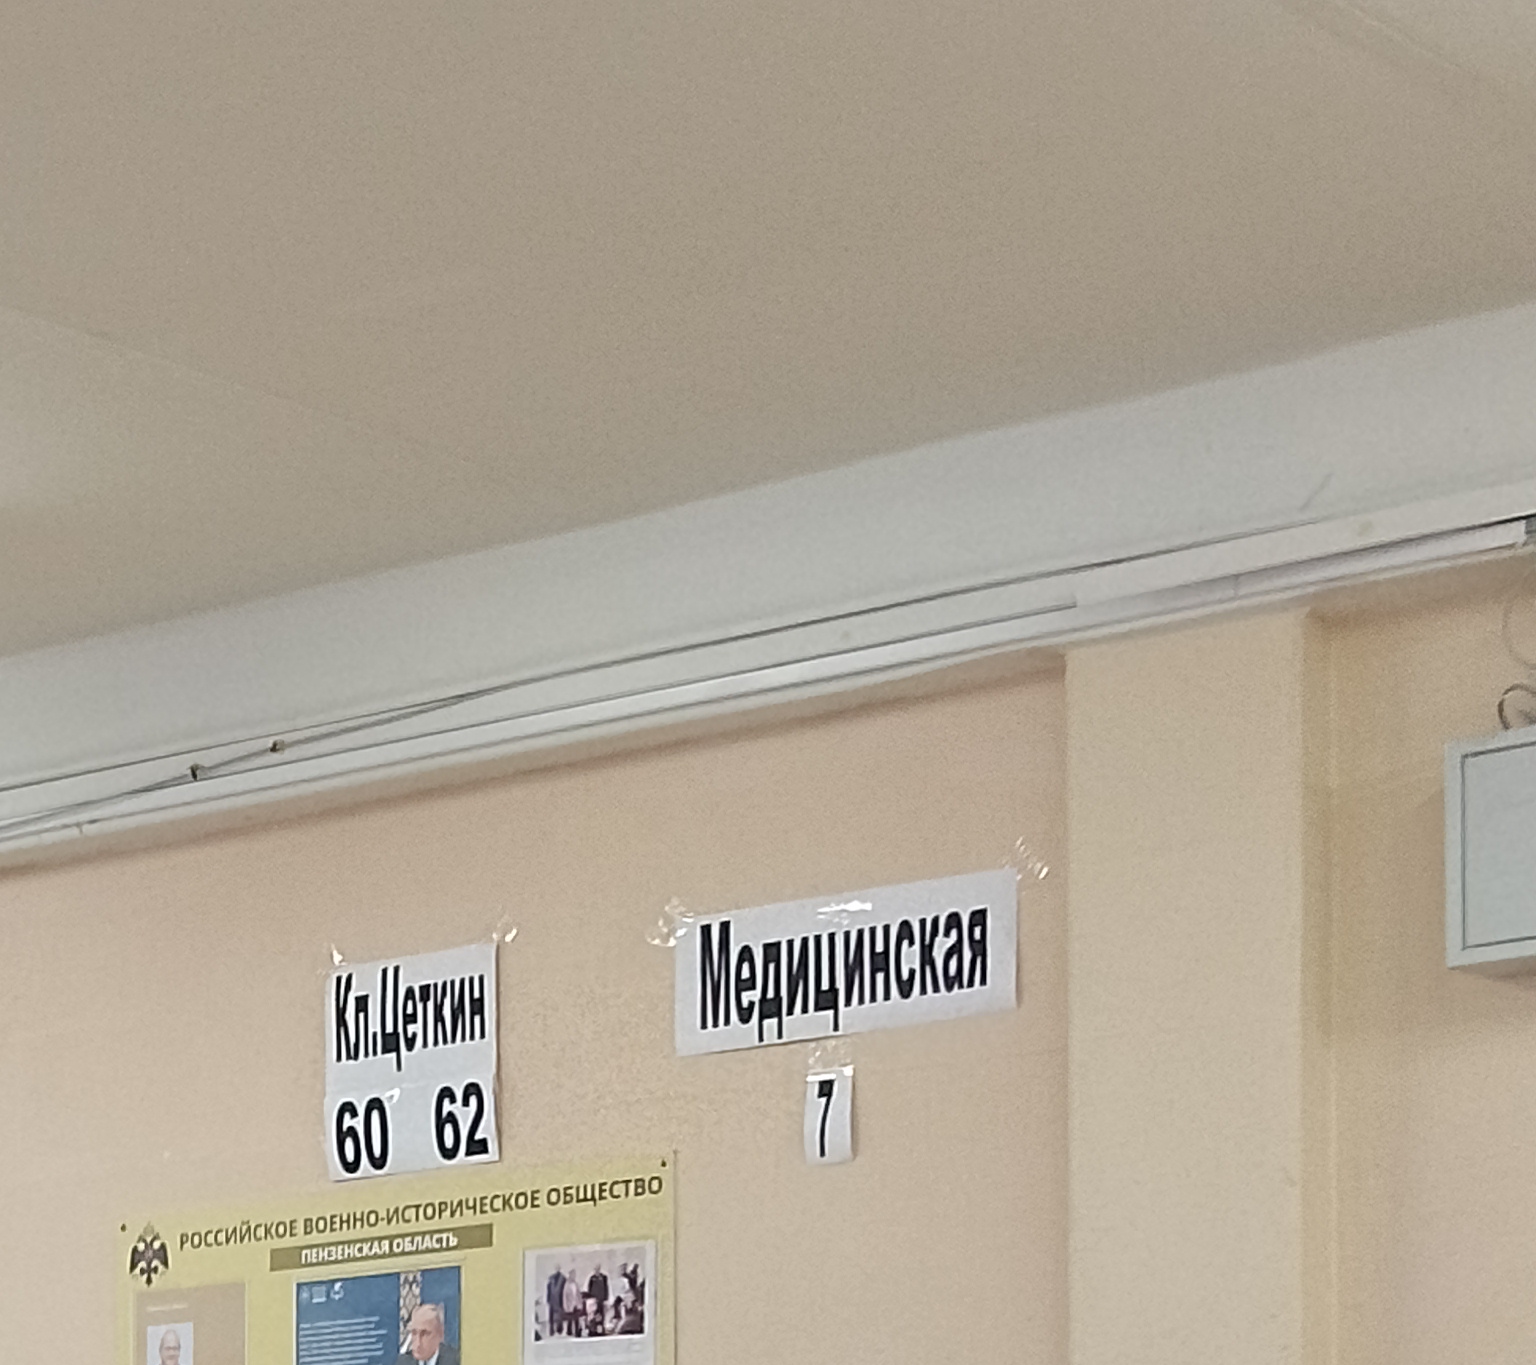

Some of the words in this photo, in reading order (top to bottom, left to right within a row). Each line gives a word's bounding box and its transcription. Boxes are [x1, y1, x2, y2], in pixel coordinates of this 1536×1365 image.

[699, 906, 989, 1043] Медицинская
[335, 964, 486, 1072] Кл.Цеткин
[336, 1096, 389, 1175] 60
[434, 1082, 489, 1161] 62
[817, 1078, 836, 1158] 7
[179, 1218, 299, 1251] РОССИЙСКОЕ
[303, 1190, 541, 1236] ВОЕННО-ИСТОРИЧЕСКОЕ
[546, 1175, 663, 1207] ОБЩЕСТВО
[300, 1240, 390, 1265] ПЕНЗЕНСКАЯ
[392, 1232, 458, 1253] ОБЛАСТЬ
